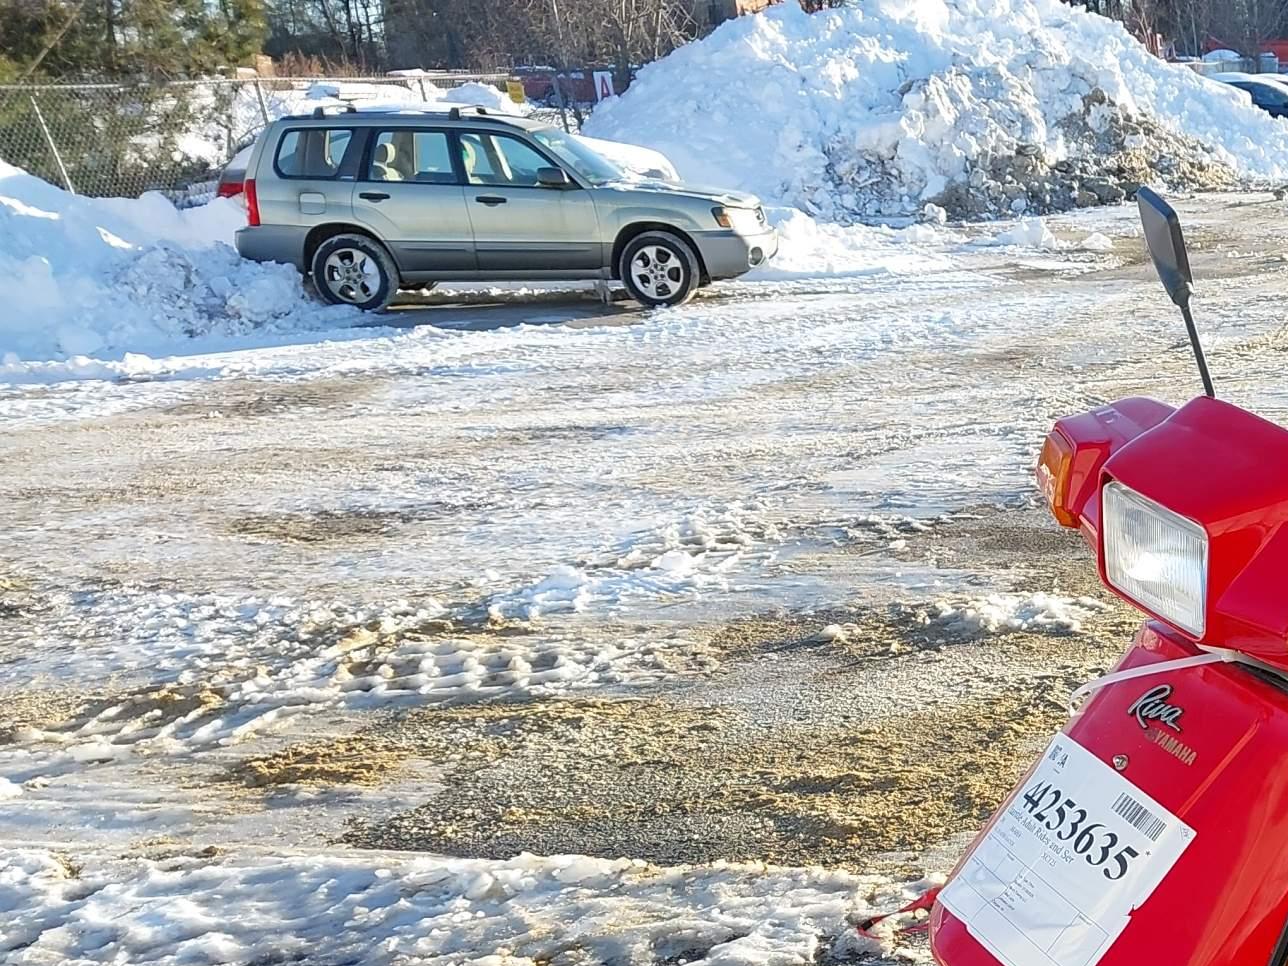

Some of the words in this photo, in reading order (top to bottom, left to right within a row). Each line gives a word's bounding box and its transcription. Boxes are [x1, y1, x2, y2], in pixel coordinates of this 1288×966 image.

[1127, 684, 1183, 732] Riva
[1154, 730, 1197, 766] YAMAHA
[1023, 780, 1140, 881] 44253635
